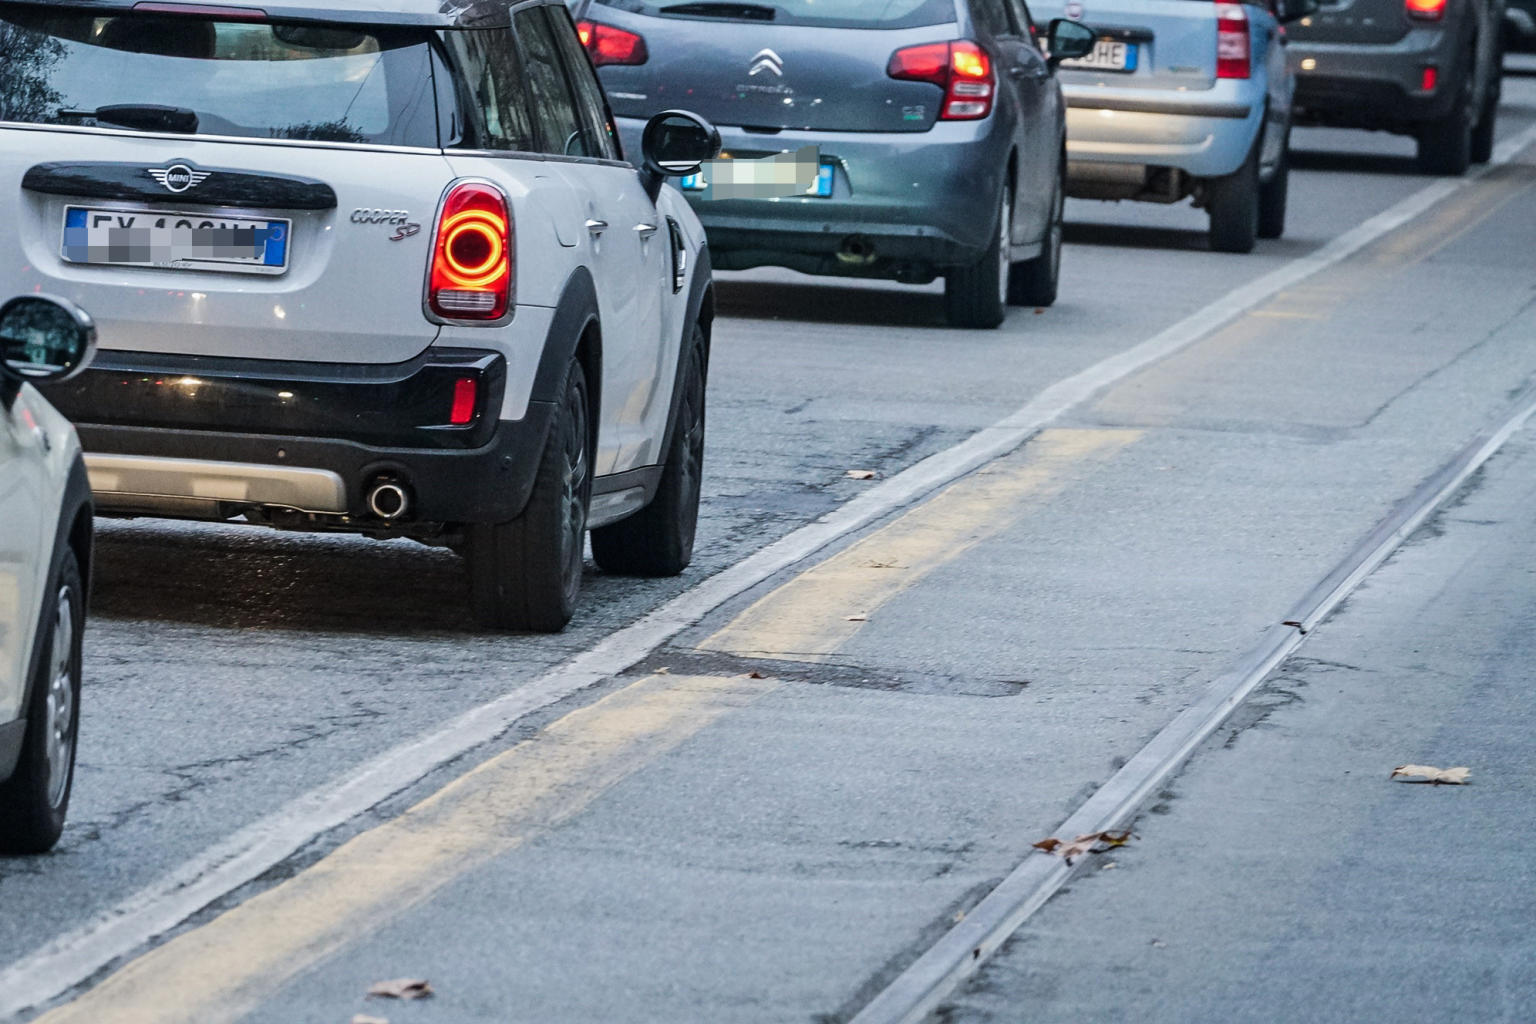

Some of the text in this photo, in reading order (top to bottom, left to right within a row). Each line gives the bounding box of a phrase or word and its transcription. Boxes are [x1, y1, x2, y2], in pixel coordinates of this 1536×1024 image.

[168, 173, 190, 183] MINI
[350, 207, 409, 226] COOPER
[389, 222, 421, 241] SD
